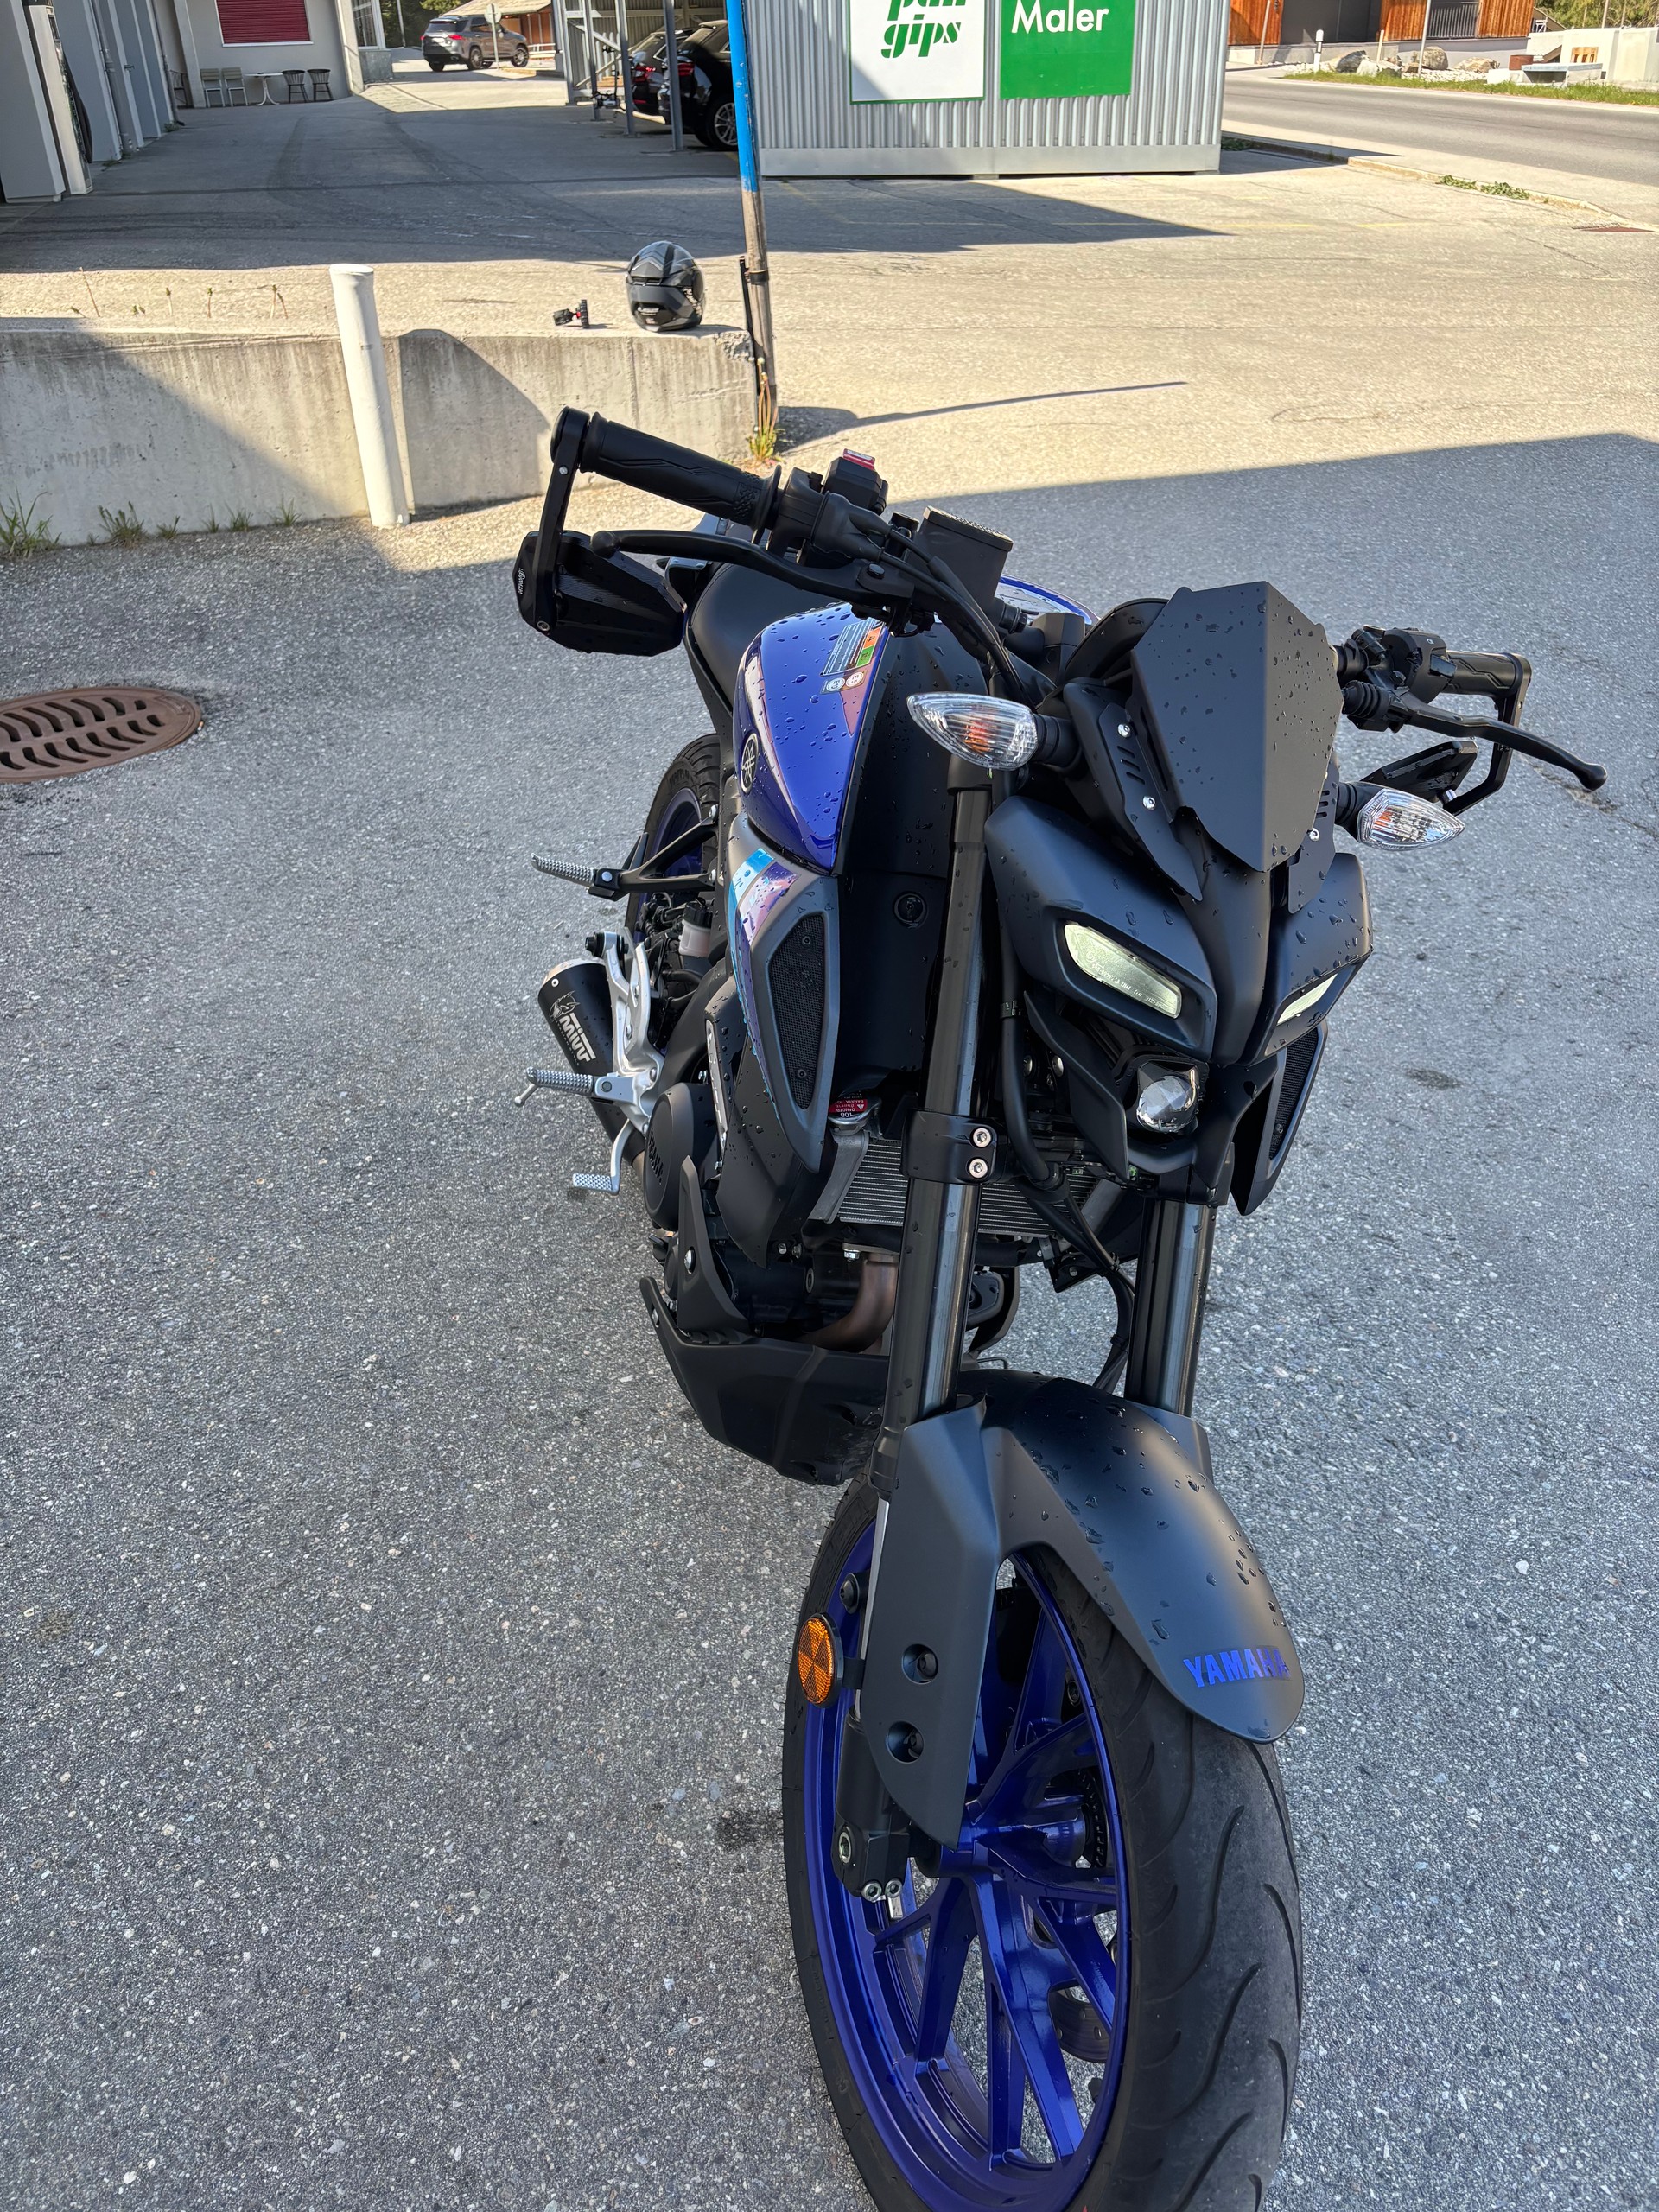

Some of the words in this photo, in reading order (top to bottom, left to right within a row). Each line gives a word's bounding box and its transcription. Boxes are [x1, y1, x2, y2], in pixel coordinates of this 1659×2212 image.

[880, 14, 962, 58] gips
[1011, 0, 1110, 34] Maler
[1183, 1648, 1290, 1688] YAMAHA
